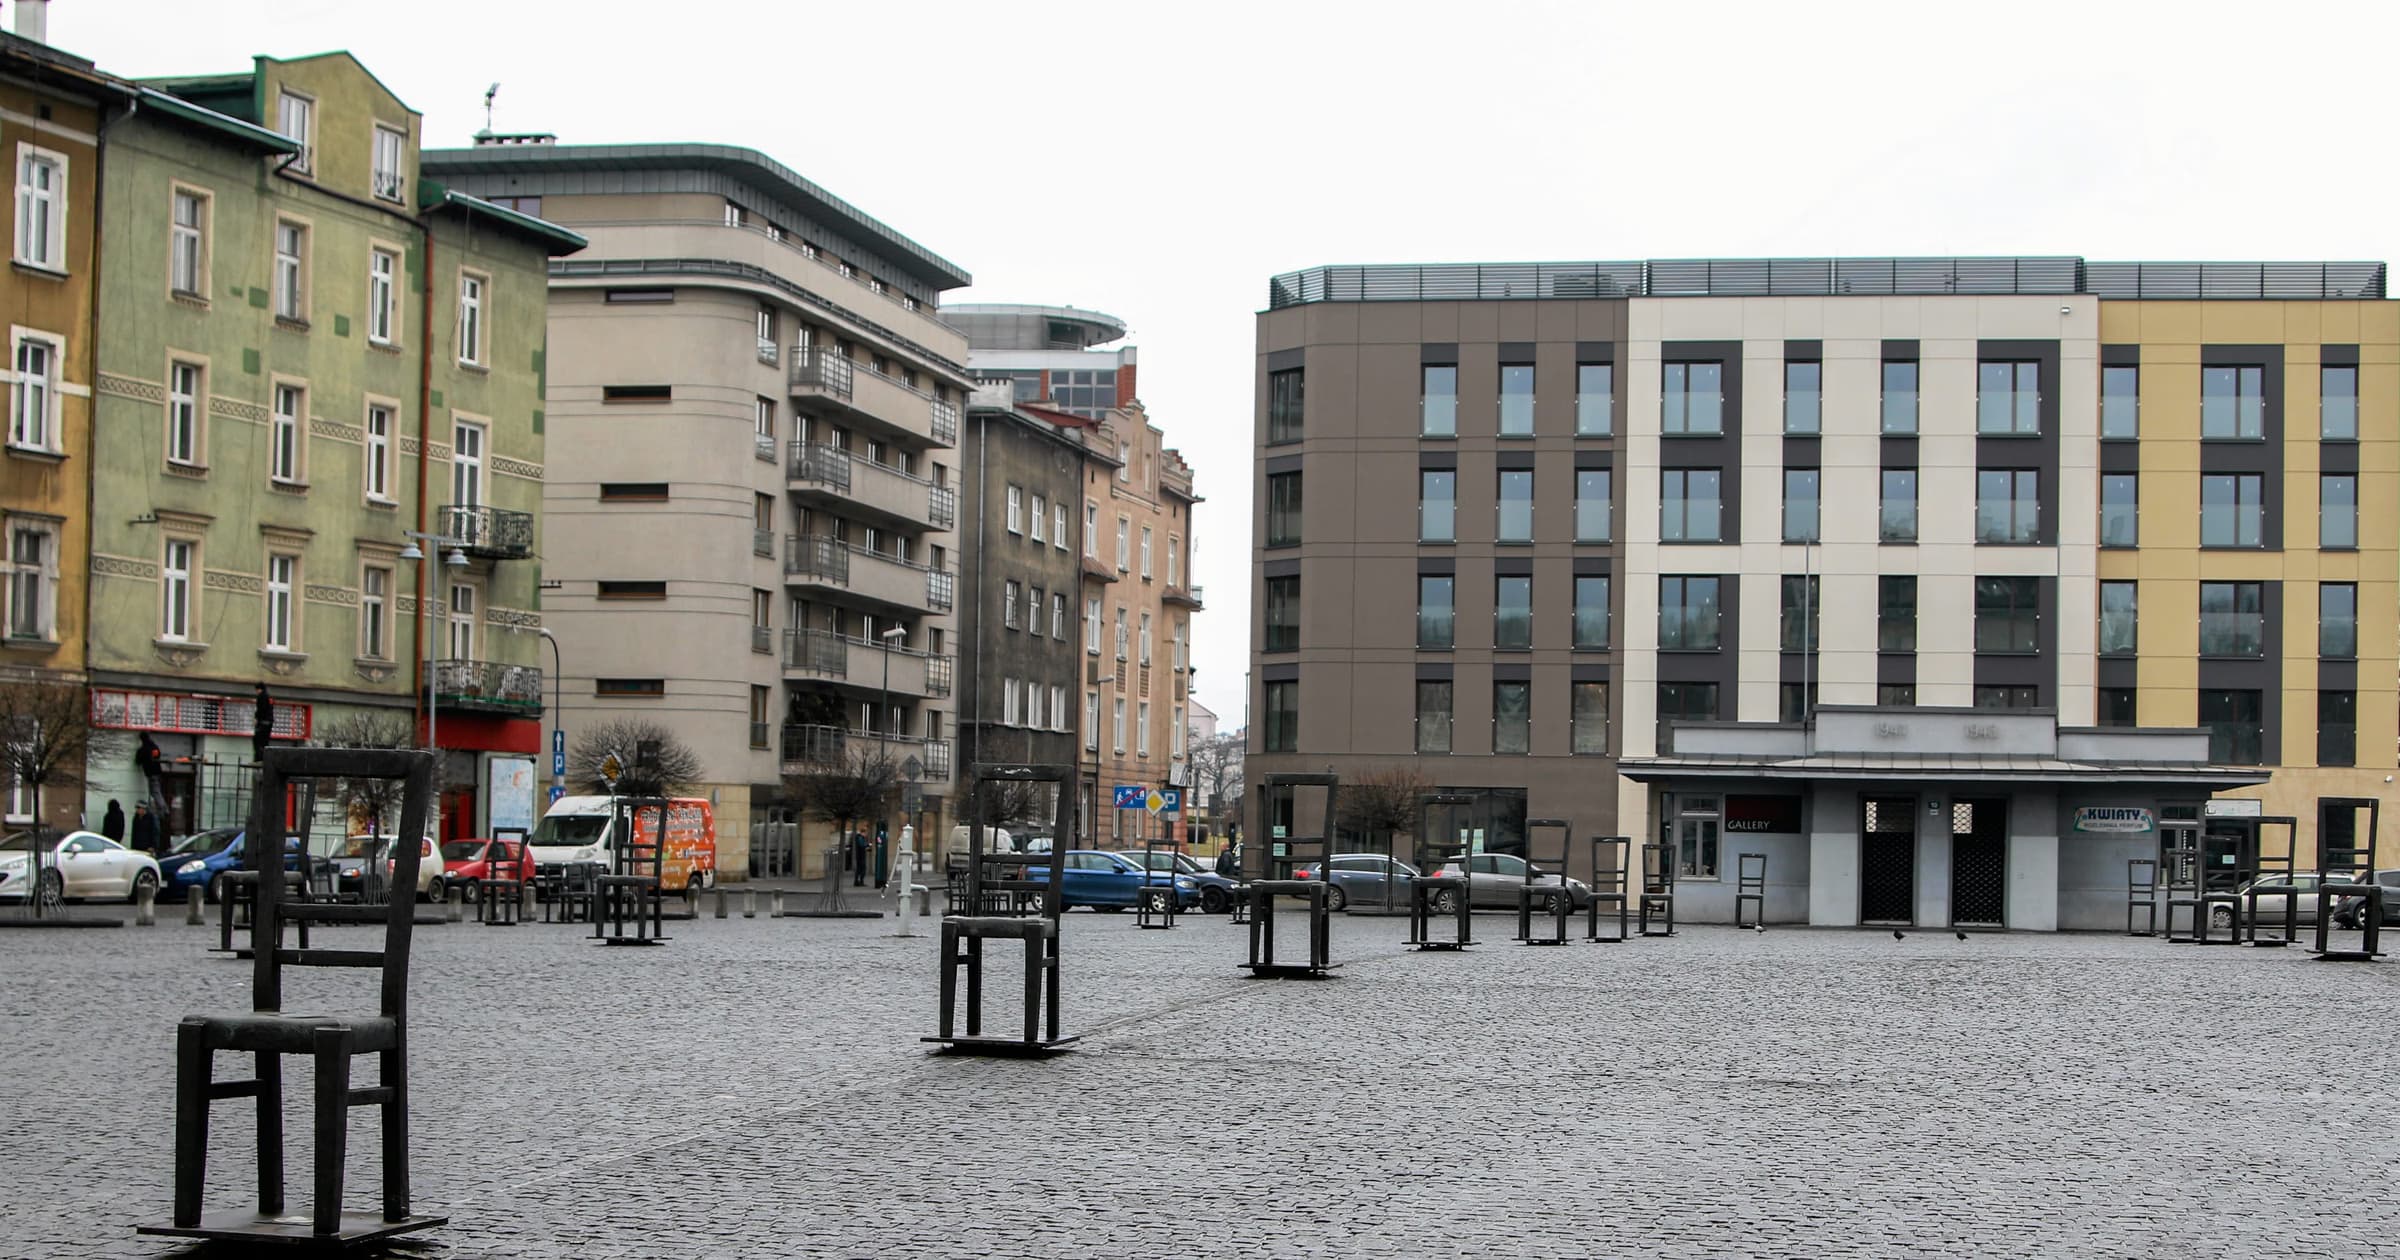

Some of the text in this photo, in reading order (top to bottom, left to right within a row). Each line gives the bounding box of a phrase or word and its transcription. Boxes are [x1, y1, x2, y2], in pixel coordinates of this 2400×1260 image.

[556, 755, 563, 773] P
[1165, 793, 1176, 808] P
[2088, 808, 2140, 820] KWIATY
[1727, 820, 1770, 830] GALLERY
